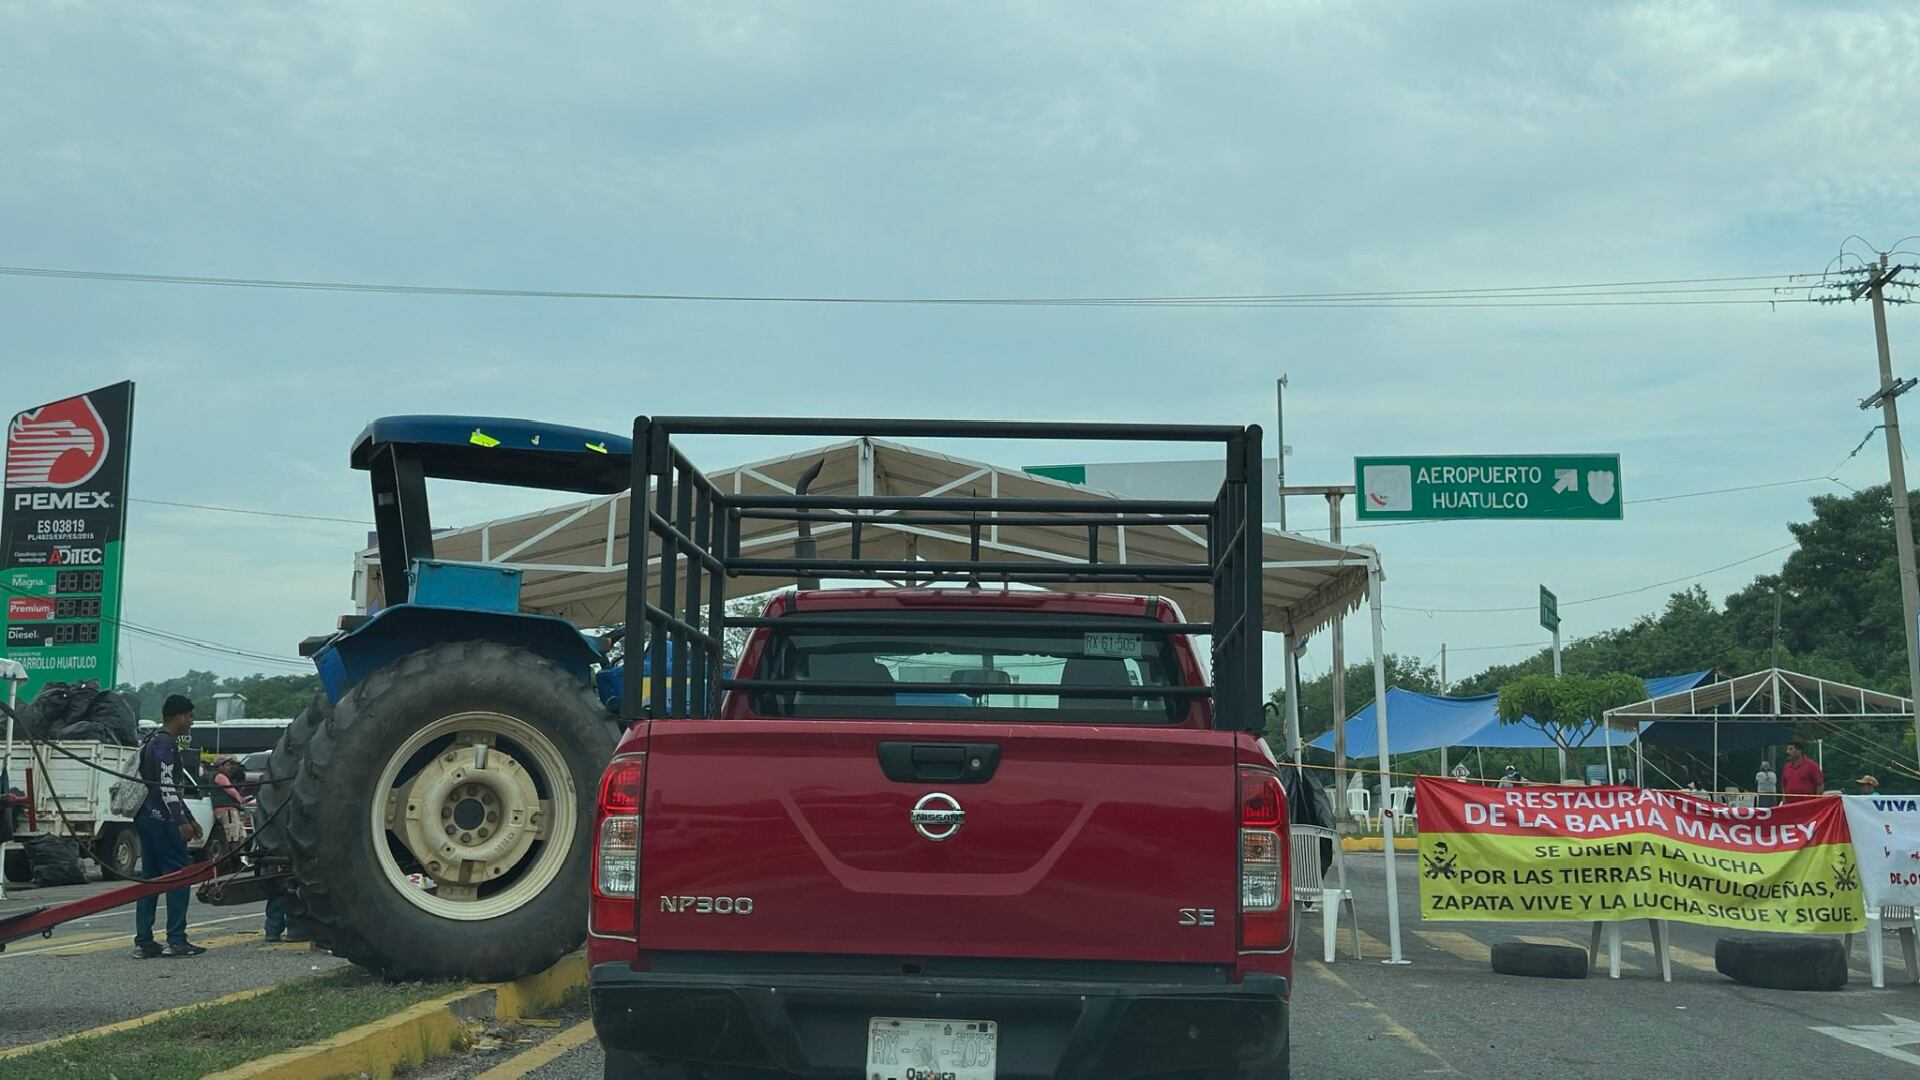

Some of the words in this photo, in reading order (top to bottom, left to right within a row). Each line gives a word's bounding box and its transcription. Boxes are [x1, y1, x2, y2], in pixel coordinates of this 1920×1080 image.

[1417, 466, 1542, 484] AEROPUERTO
[15, 491, 111, 511] PEMEX
[1432, 492, 1528, 509] HUATULCO
[37, 520, 51, 533] ES
[52, 519, 85, 533] 03819
[12, 578, 44, 588] Magna
[10, 605, 50, 613] Premium
[8, 630, 37, 639] Diesel
[56, 655, 97, 669] HUATULCO
[1872, 800, 1918, 812] VIVA
[916, 814, 959, 822] NISSAN
[1465, 803, 1507, 827] DE
[1516, 808, 1557, 829] LA
[1565, 807, 1668, 833] BAHIA
[1675, 816, 1817, 847] MAGUEY
[1535, 845, 1560, 858] SE
[1568, 841, 1633, 857] UNEN
[1640, 841, 1656, 857] A
[1662, 844, 1688, 861] LA
[1693, 852, 1765, 875] LUCHA
[1460, 869, 1507, 885] POR
[1514, 869, 1553, 884] LAS
[1559, 865, 1652, 884] TIERRAS
[1659, 867, 1835, 900] HUATULQUEÑAS,
[660, 896, 753, 915] NP300
[1432, 895, 1514, 911] ZAPATA
[1520, 895, 1573, 911] VIVE
[1579, 894, 1593, 910] Y
[1601, 894, 1627, 909] LA
[1633, 892, 1704, 915] LUCHA
[1708, 903, 1769, 922] SIGUE
[1775, 908, 1789, 923] Y
[1796, 907, 1858, 923] SIGUE.
[1179, 908, 1215, 926] SE
[872, 1034, 993, 1068] RX--505
